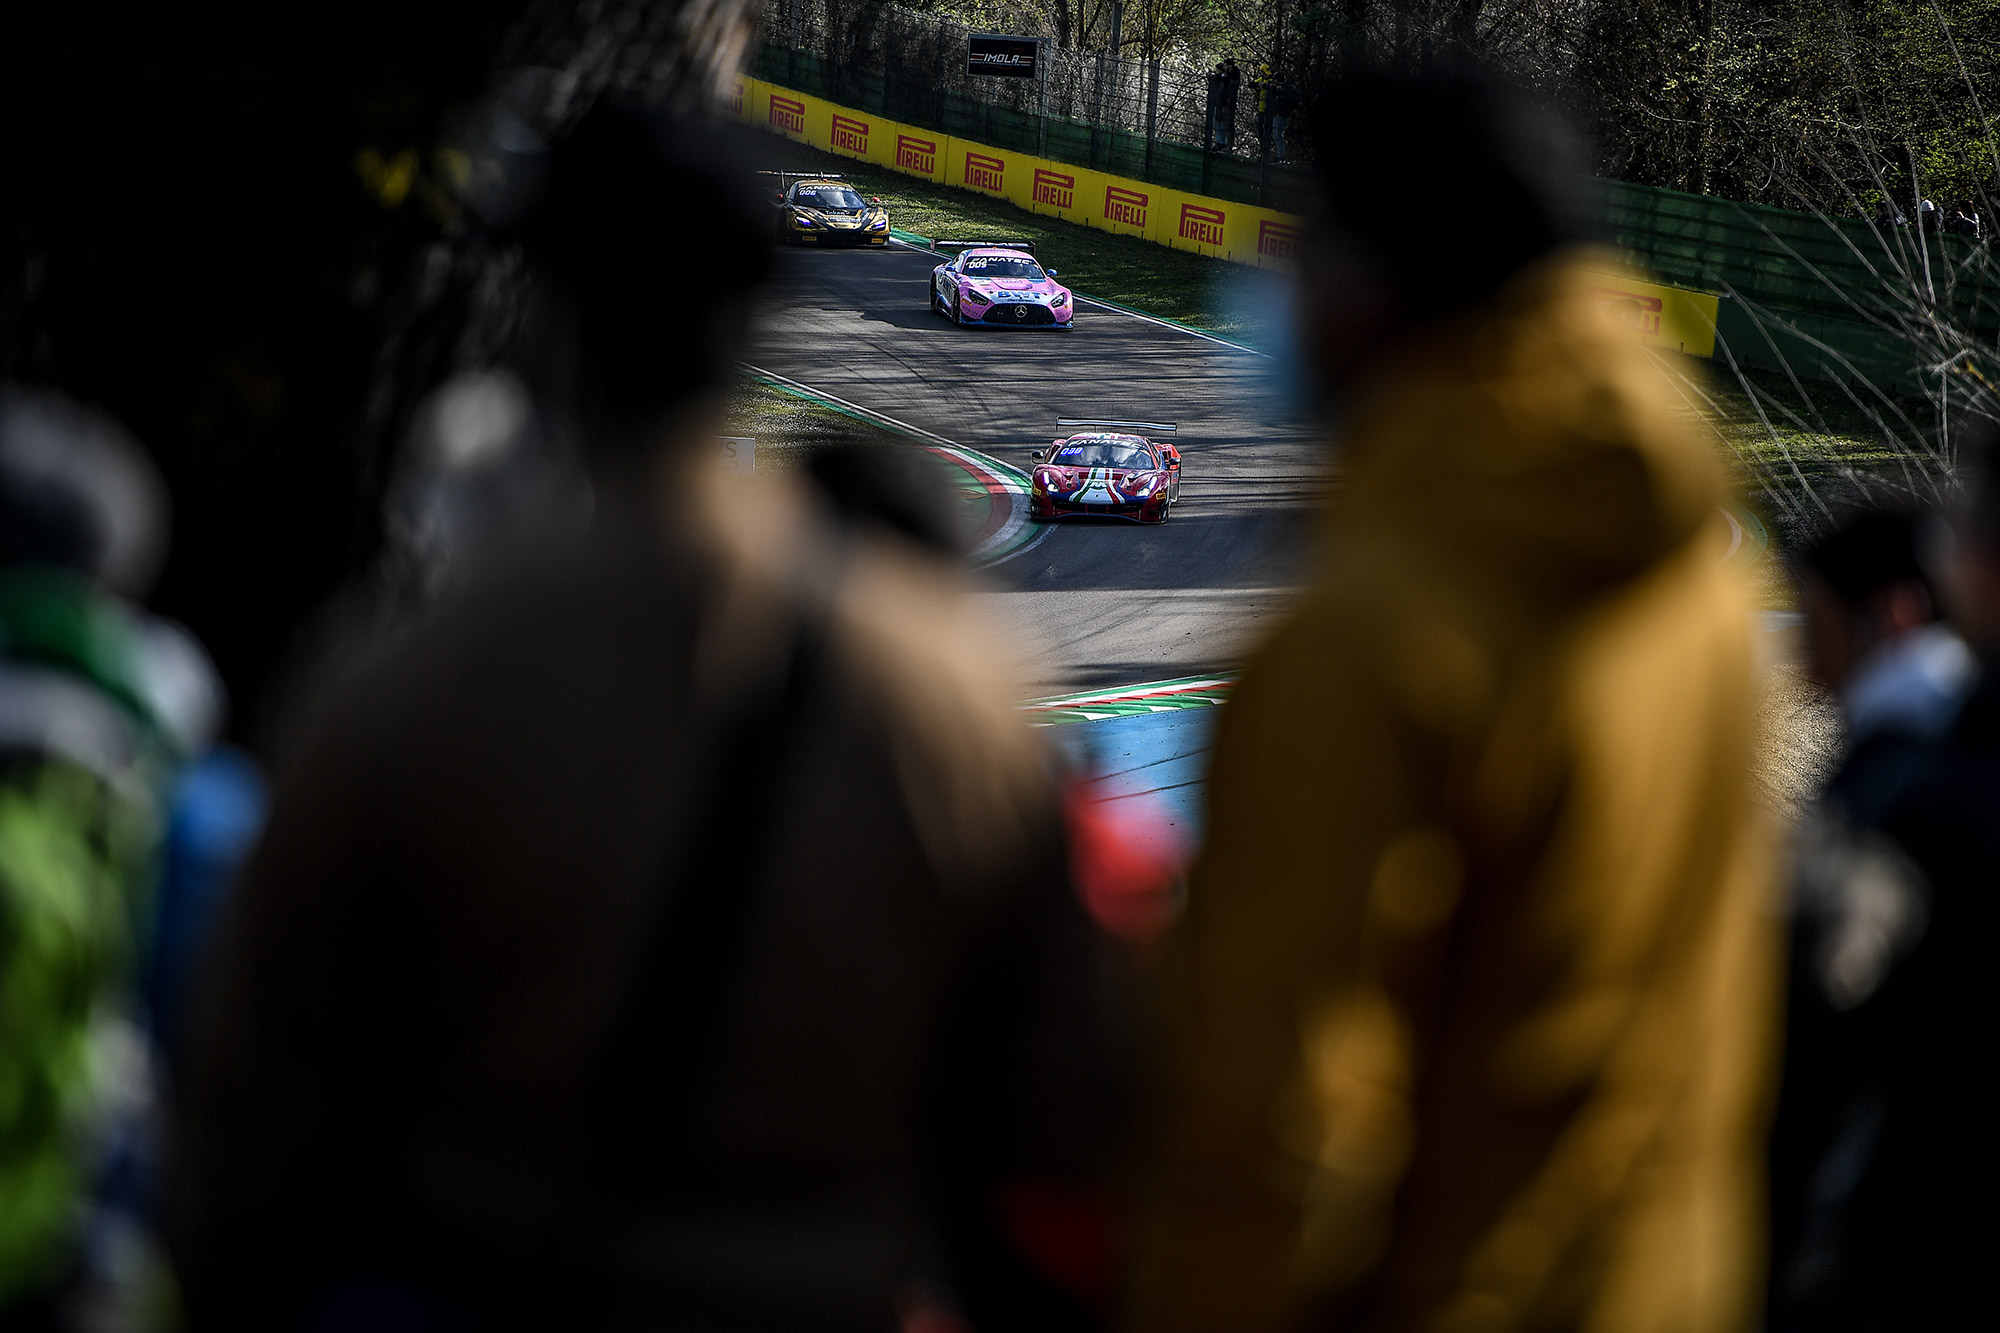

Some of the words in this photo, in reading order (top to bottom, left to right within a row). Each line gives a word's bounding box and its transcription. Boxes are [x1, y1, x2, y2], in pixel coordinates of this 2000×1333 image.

[983, 53, 1020, 64] IMOLA
[769, 94, 805, 134] PIRELLI
[830, 113, 870, 154] PIRELLI
[896, 134, 936, 174] PIRELLI
[964, 152, 1005, 192] PIRELLI
[1032, 168, 1075, 209] PIRELLI
[1104, 185, 1148, 228] PIRELLI
[1178, 203, 1225, 245] PIRELLI
[972, 256, 1033, 264] FANATEC
[998, 290, 1040, 300] BWT
[1068, 439, 1142, 449] FANATEC
